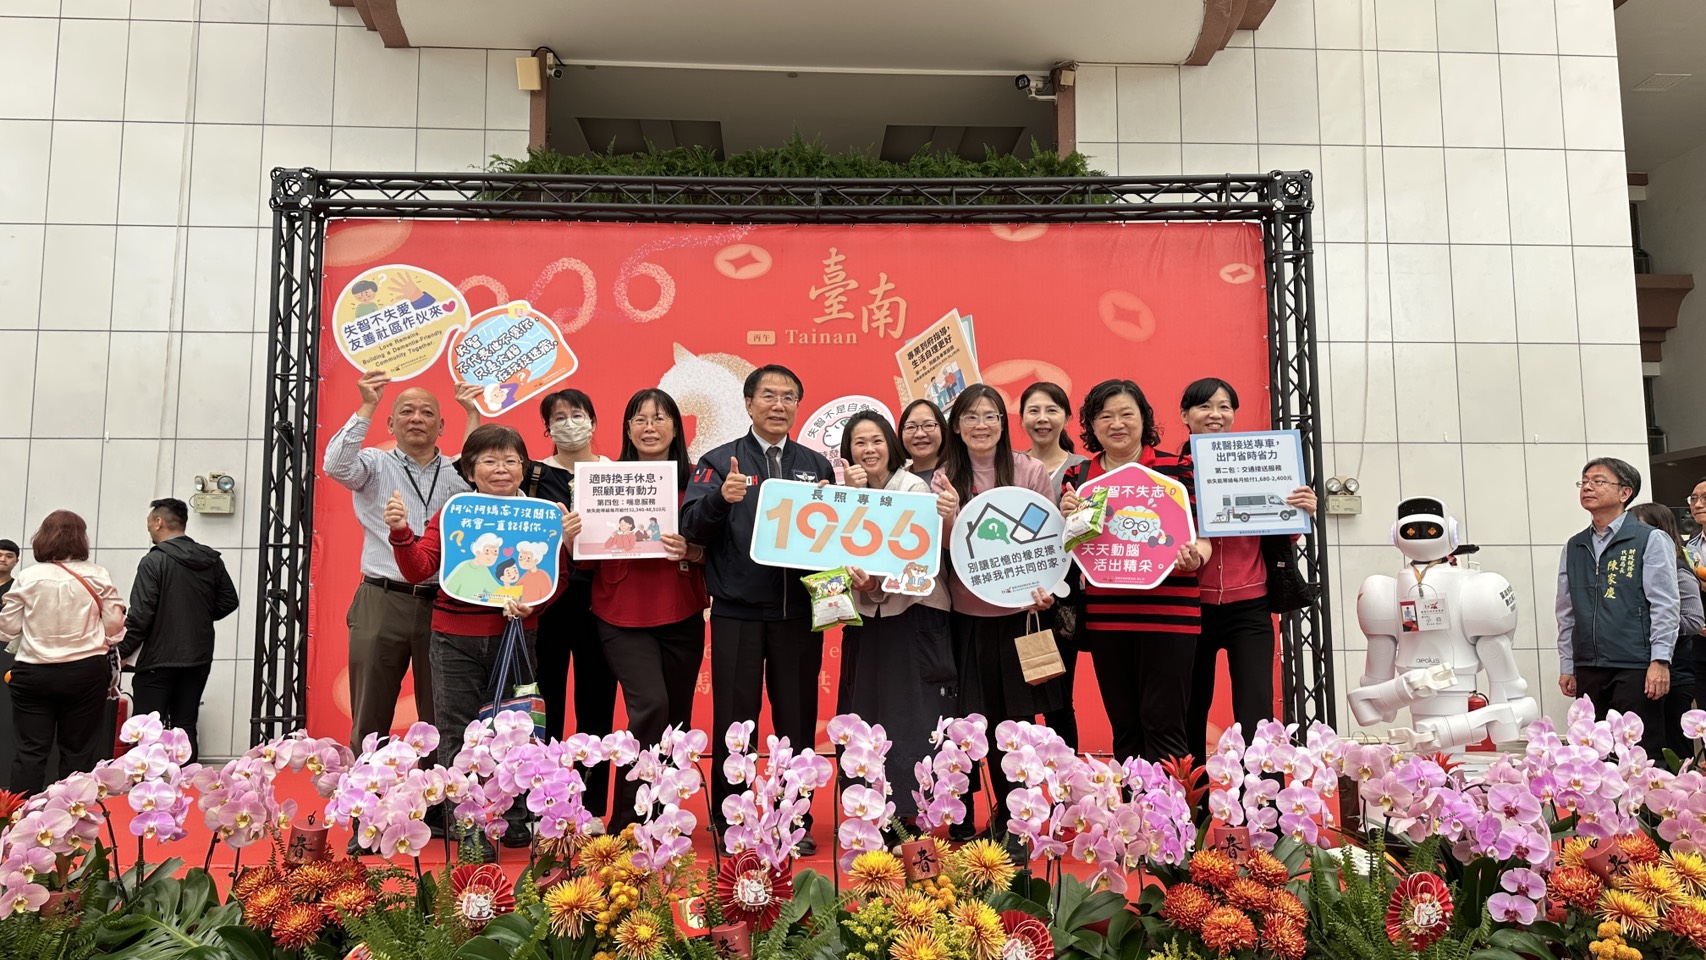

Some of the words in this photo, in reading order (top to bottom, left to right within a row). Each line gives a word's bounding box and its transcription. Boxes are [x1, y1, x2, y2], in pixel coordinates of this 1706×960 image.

[809, 247, 907, 339] 臺南
[344, 302, 411, 338] 失智不失愛
[348, 305, 443, 352] 友善社區作伙來
[362, 353, 385, 365] Building
[393, 330, 442, 353] Dementia-Friendly
[379, 342, 393, 351] Love
[455, 335, 482, 357] 失智
[785, 328, 857, 344] Tainan
[375, 352, 406, 367] Community
[474, 344, 521, 380] 只是大腦
[911, 334, 952, 369] 生活自理更好
[1216, 450, 1278, 462] 出門省時省力
[592, 485, 657, 496] 照顧更有動力
[811, 489, 893, 507] 長照專線
[765, 498, 931, 561] 1966
[1081, 543, 1140, 557] 天天動腦
[1619, 549, 1627, 574] 代理局長
[1604, 559, 1618, 599] 陳家慶
[1220, 834, 1247, 859] 春
[912, 847, 936, 872] 春
